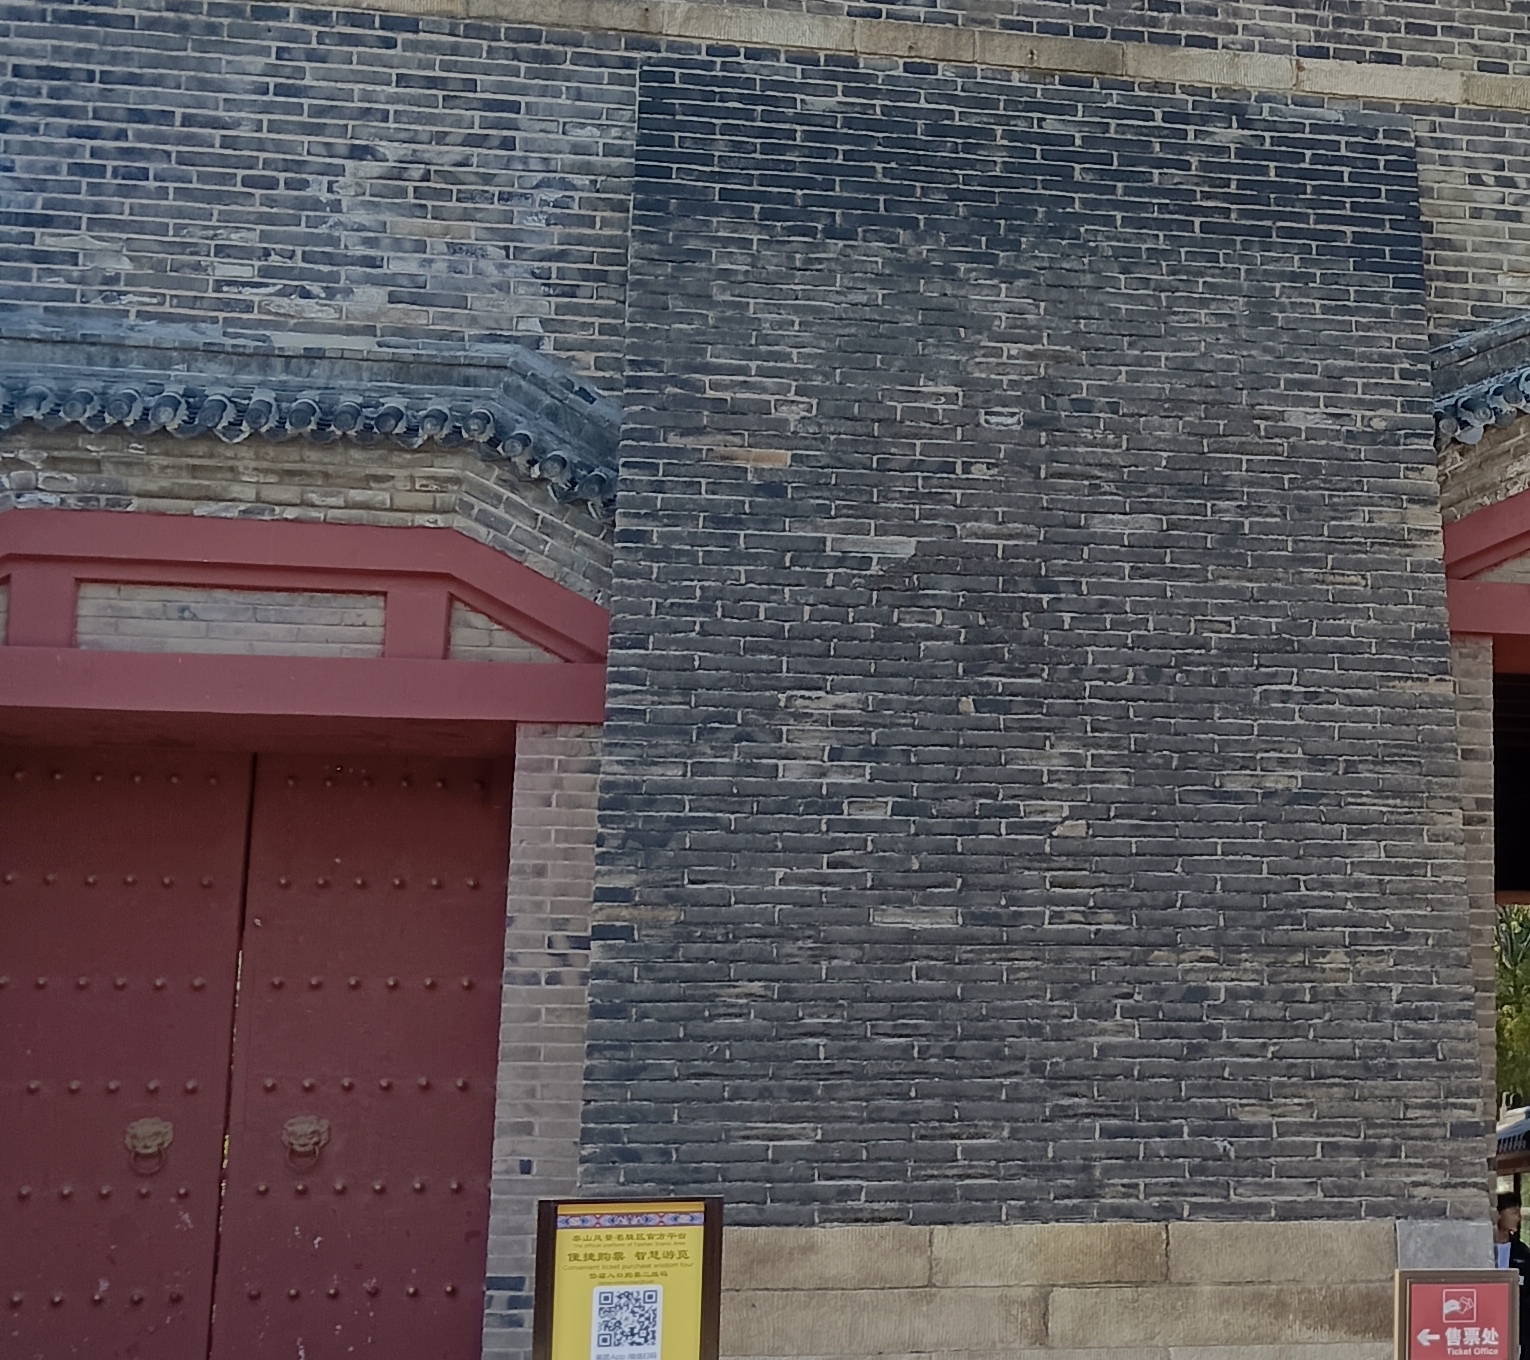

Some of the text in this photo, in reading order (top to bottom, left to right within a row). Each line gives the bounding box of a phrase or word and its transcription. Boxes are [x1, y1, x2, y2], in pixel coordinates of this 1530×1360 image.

[567, 1249, 690, 1262] 便捷购票 智慧游览
[1444, 1327, 1499, 1346] 售票处
[1446, 1347, 1499, 1356] Ticket Office
